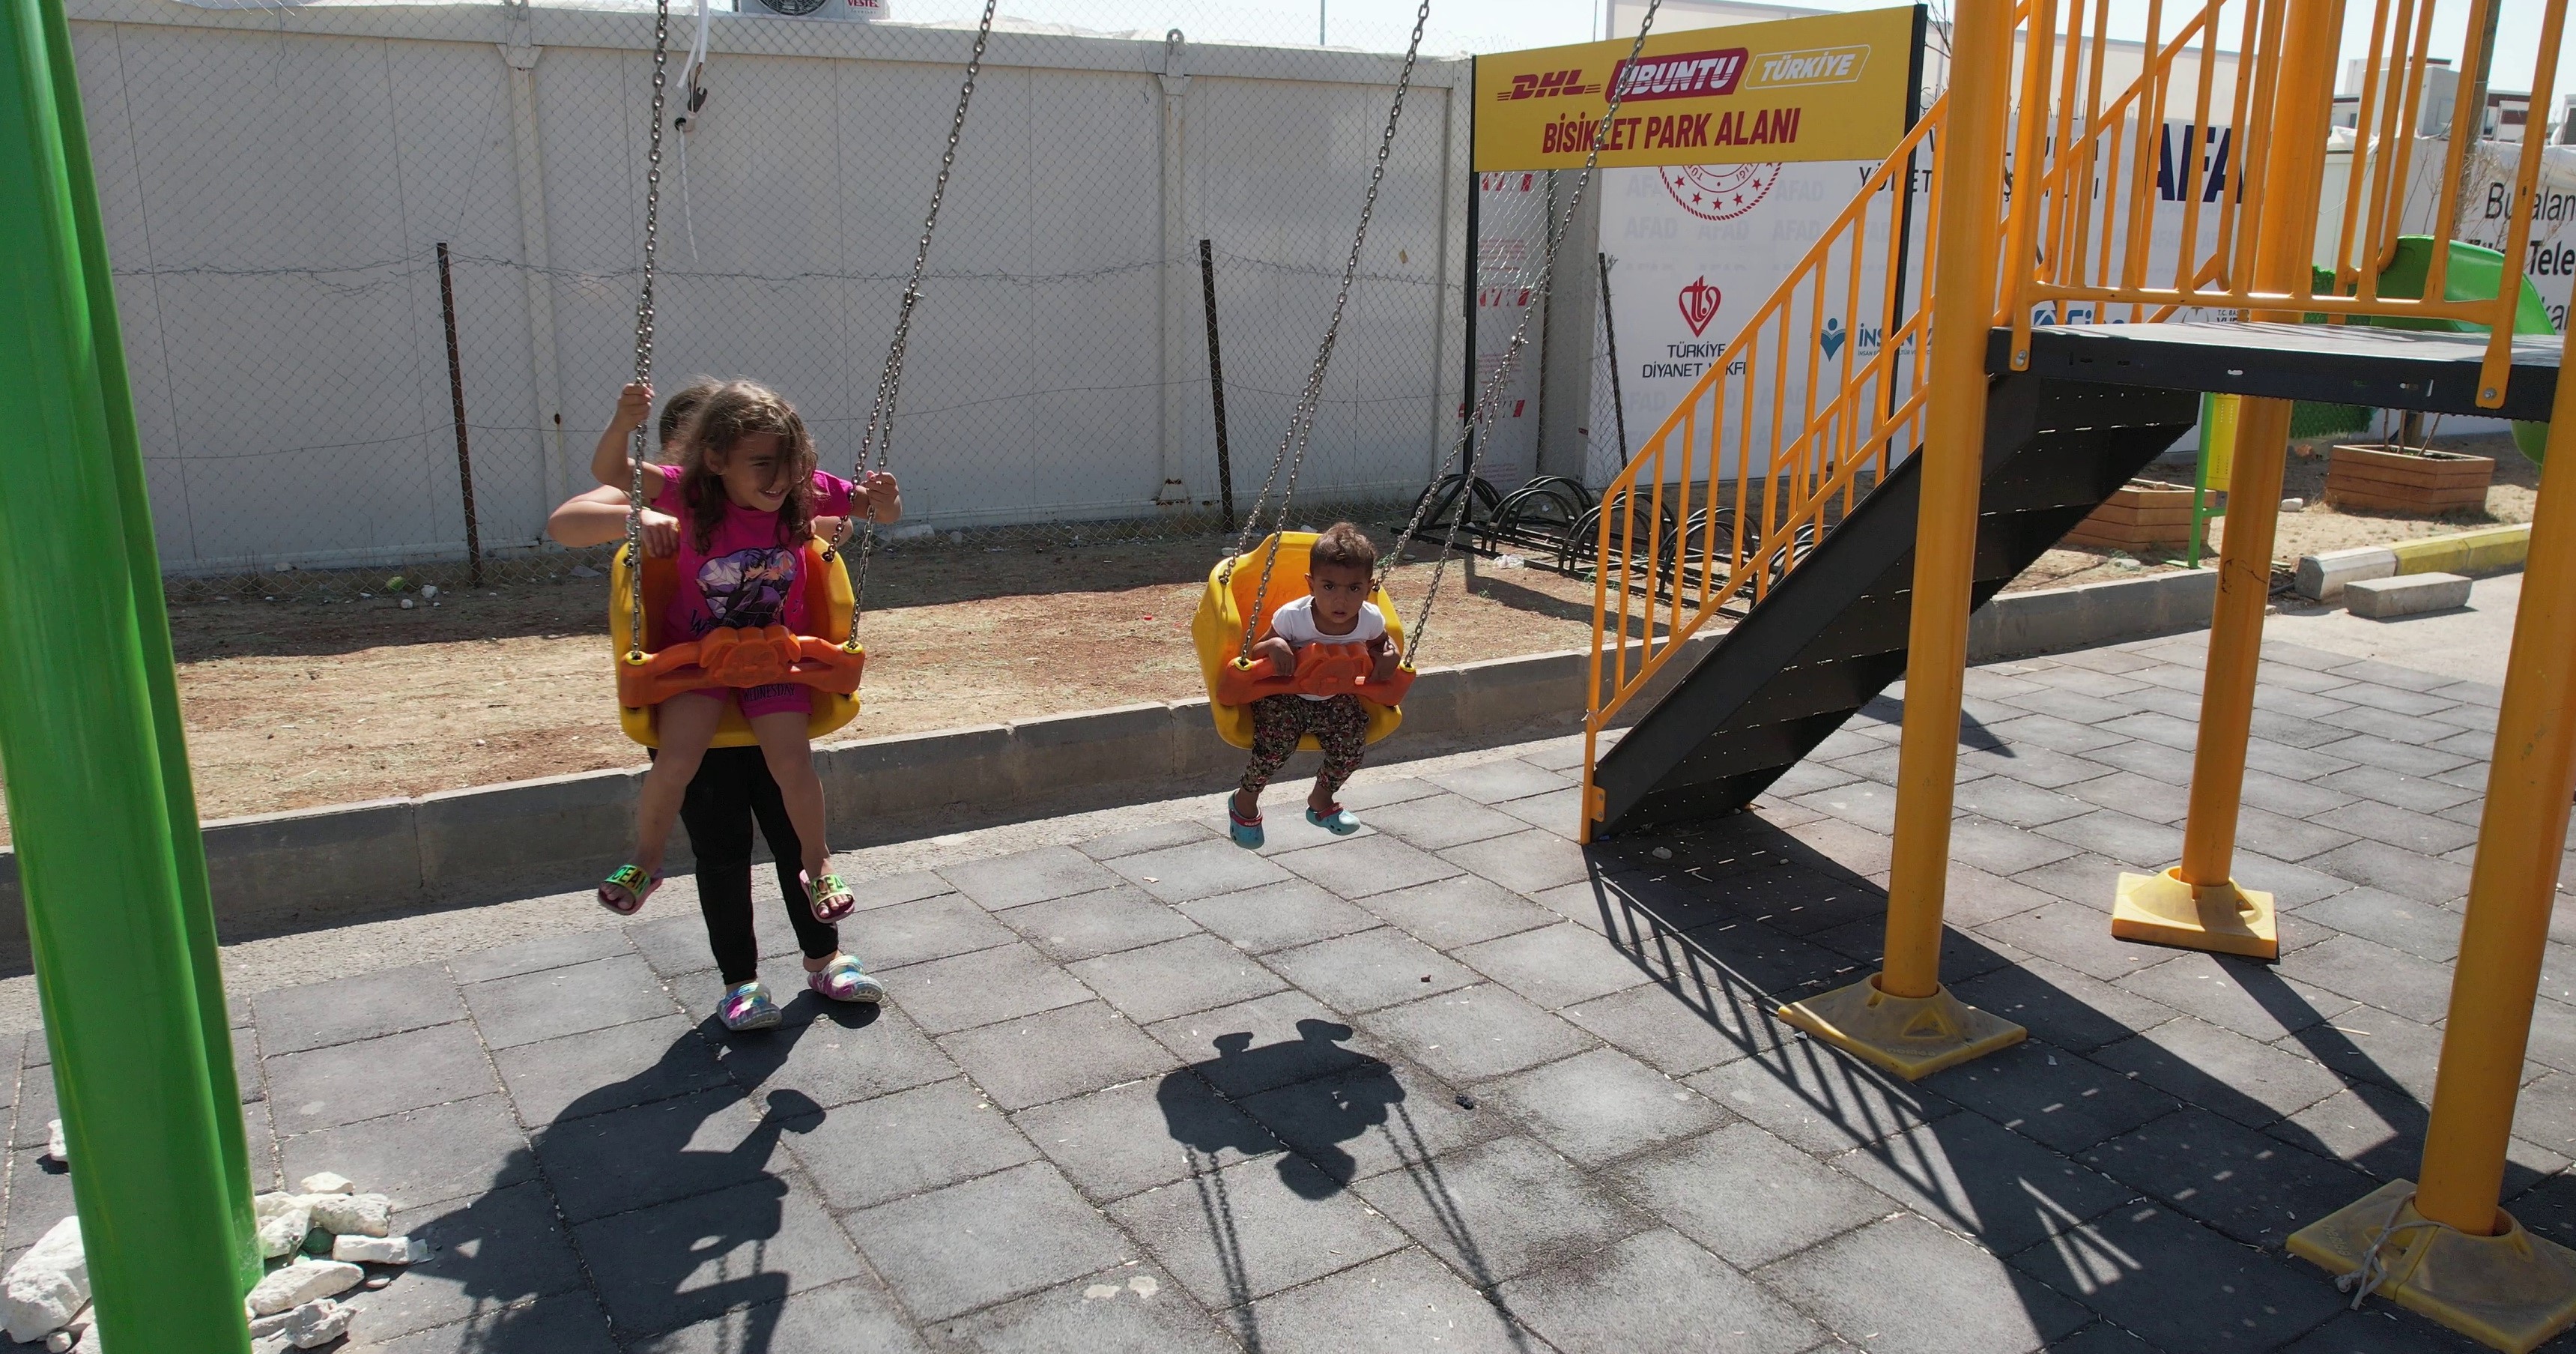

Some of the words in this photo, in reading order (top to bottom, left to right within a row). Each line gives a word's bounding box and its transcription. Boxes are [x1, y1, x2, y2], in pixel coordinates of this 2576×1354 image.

[1509, 69, 1587, 100] DHL
[1614, 55, 1740, 96] UBUNTU
[1761, 50, 1856, 82] TÜRKİYE
[1643, 112, 1712, 149] PARK
[1713, 107, 1801, 146] ALANI
[1667, 341, 1726, 359] TÜRKİYE
[1642, 360, 1703, 378] DİYANET
[743, 683, 795, 701] WEDNESDAY
